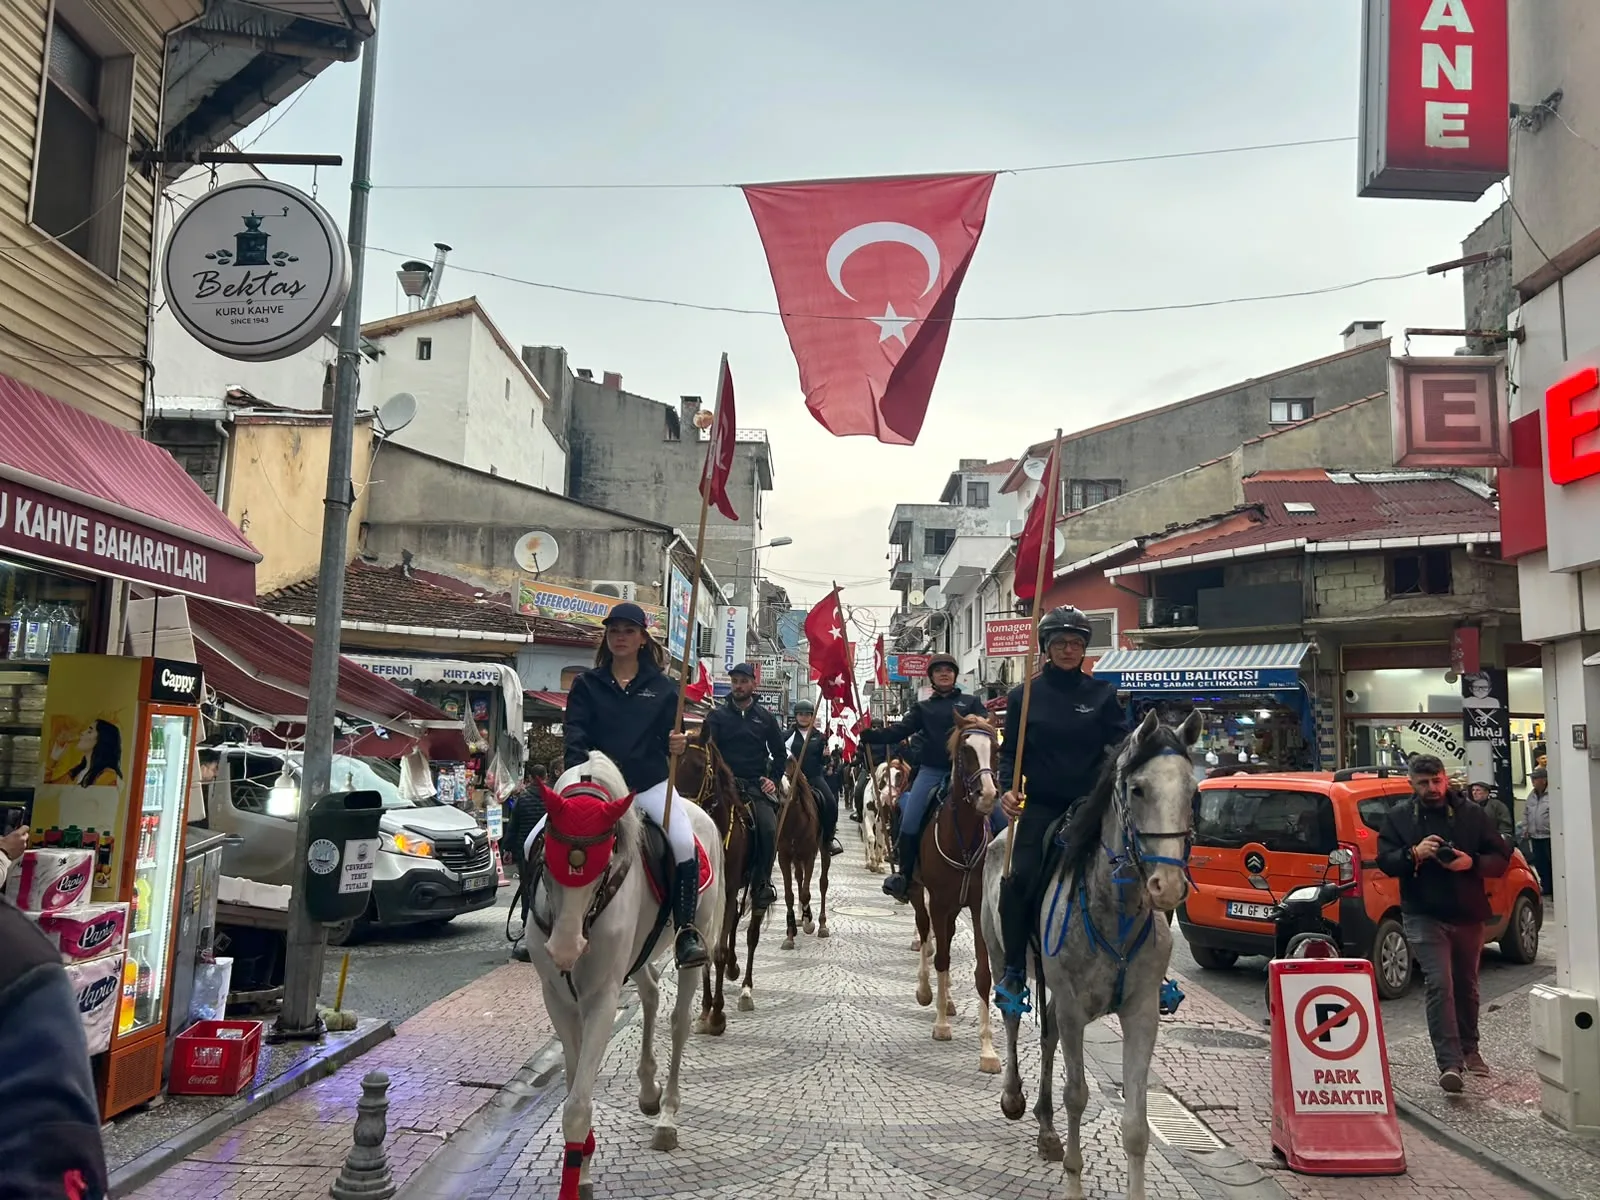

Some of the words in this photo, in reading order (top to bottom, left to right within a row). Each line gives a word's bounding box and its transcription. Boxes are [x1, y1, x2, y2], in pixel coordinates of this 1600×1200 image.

[192, 270, 307, 298] Bektaş
[215, 307, 245, 316] KURU
[247, 305, 284, 315] KAHVE
[1422, 379, 1481, 442] E
[14, 496, 89, 552] KAHVE
[93, 522, 207, 584] BAHARATLARI
[534, 591, 609, 617] SEFEROĞULLARI
[986, 622, 1033, 634] komagen
[371, 664, 413, 676] EFENDİ
[443, 669, 499, 680] KIRTASİYE
[1121, 672, 1180, 681] İNEBOLU
[1185, 670, 1259, 682] BALIKÇISI
[161, 668, 195, 693] Cappy
[1233, 904, 1243, 914] 34
[1247, 905, 1259, 916] GF
[1313, 1069, 1361, 1084] PARK
[1296, 1090, 1384, 1105] YASAKTIR
